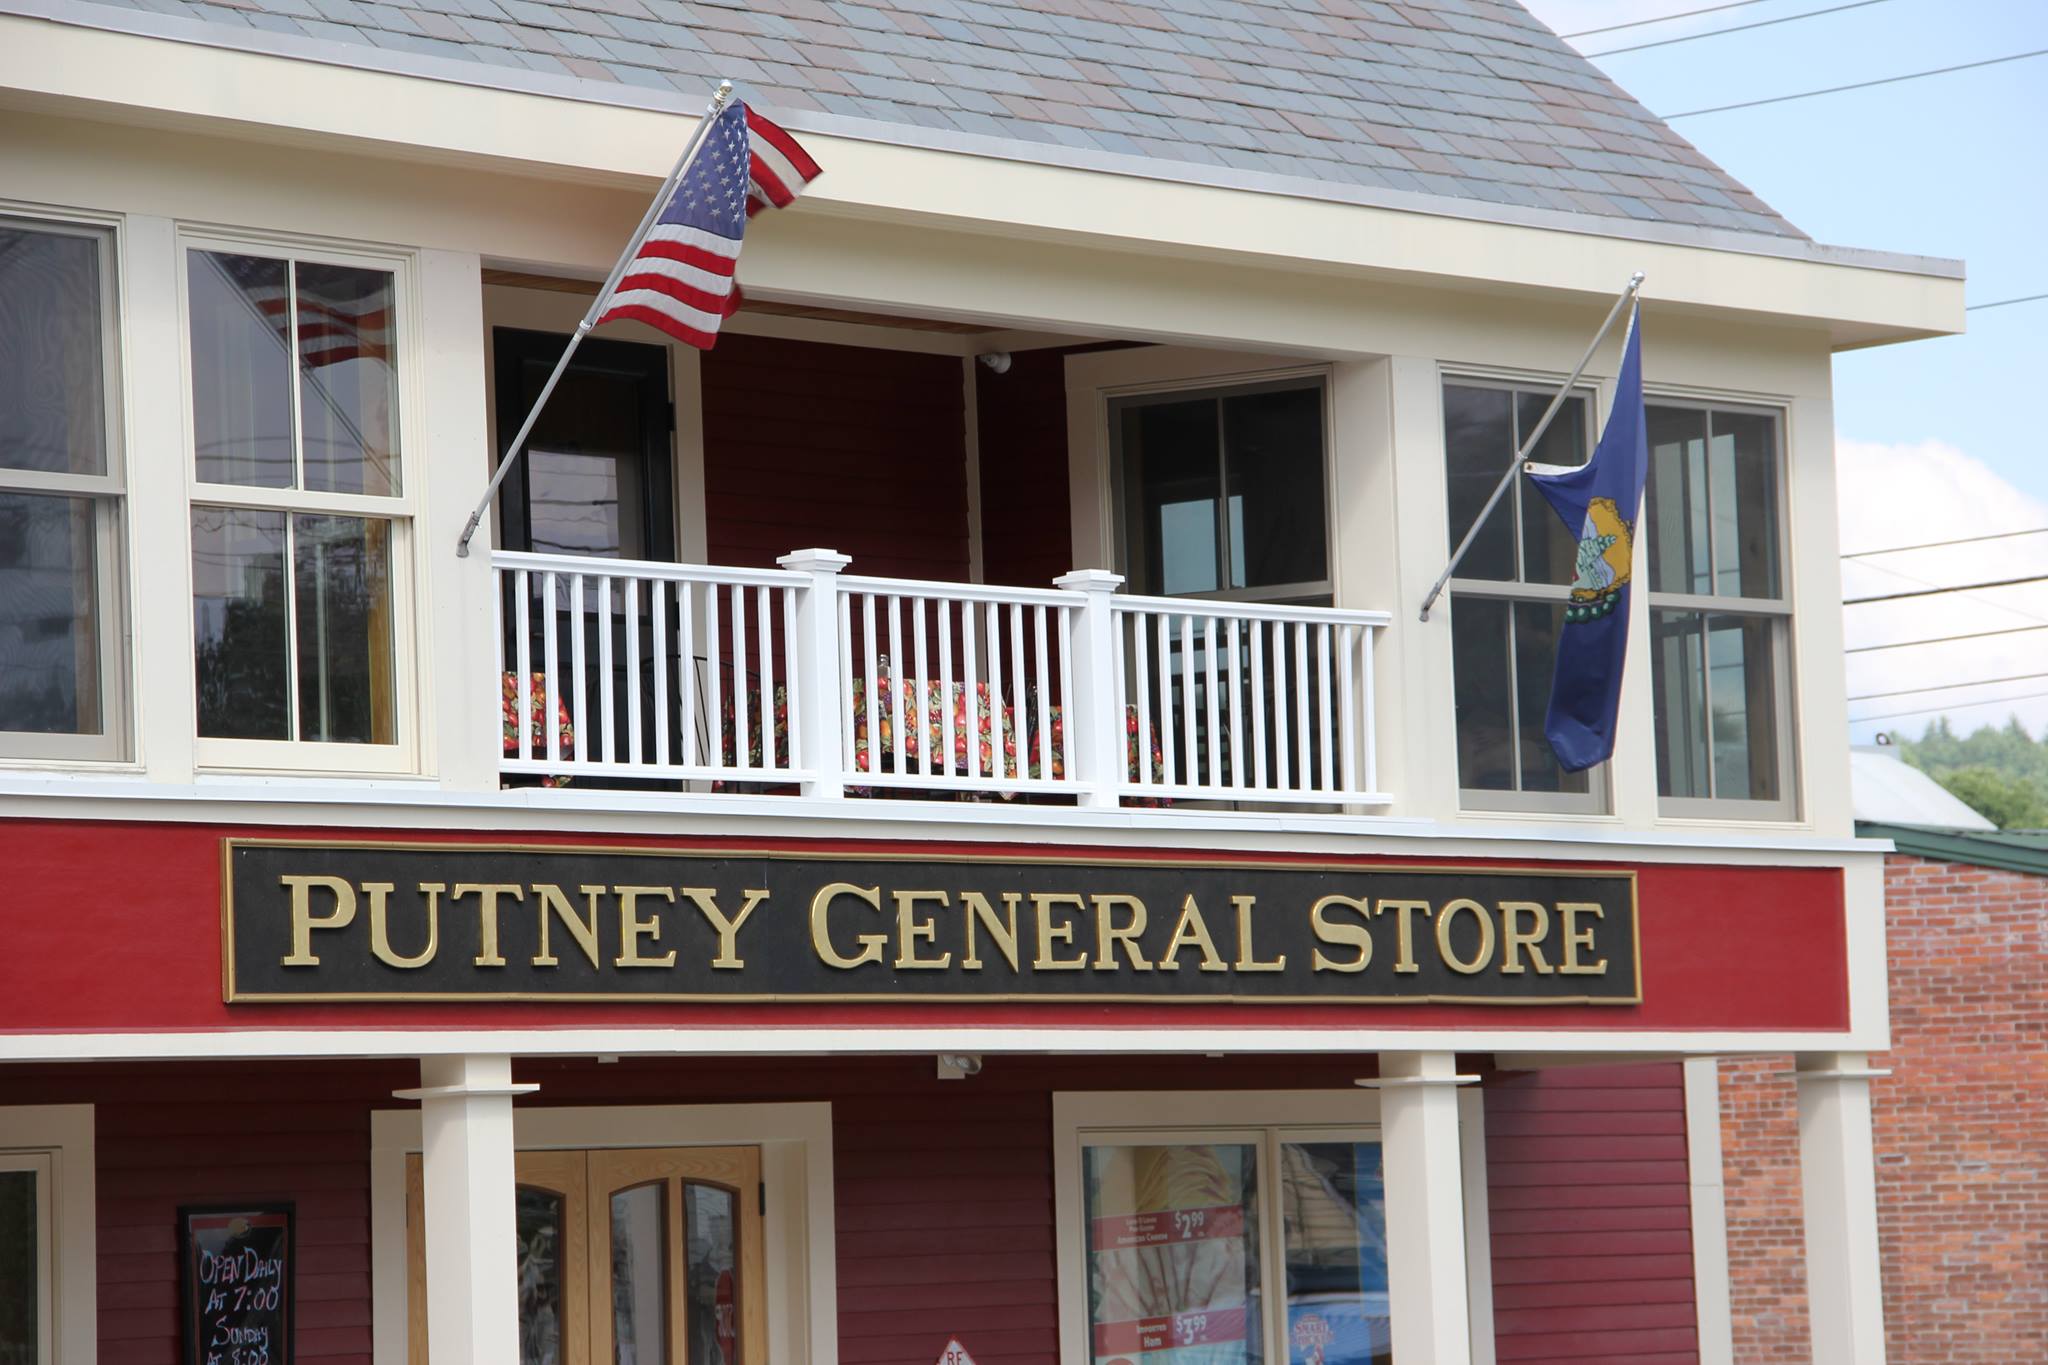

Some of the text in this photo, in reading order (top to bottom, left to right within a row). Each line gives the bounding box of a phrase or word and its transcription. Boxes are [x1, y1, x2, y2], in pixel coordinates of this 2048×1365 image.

[280, 875, 1608, 978] PUTNEY GENERAL STORE
[200, 1249, 244, 1284] OPEN
[205, 1285, 279, 1315] AT 7:00
